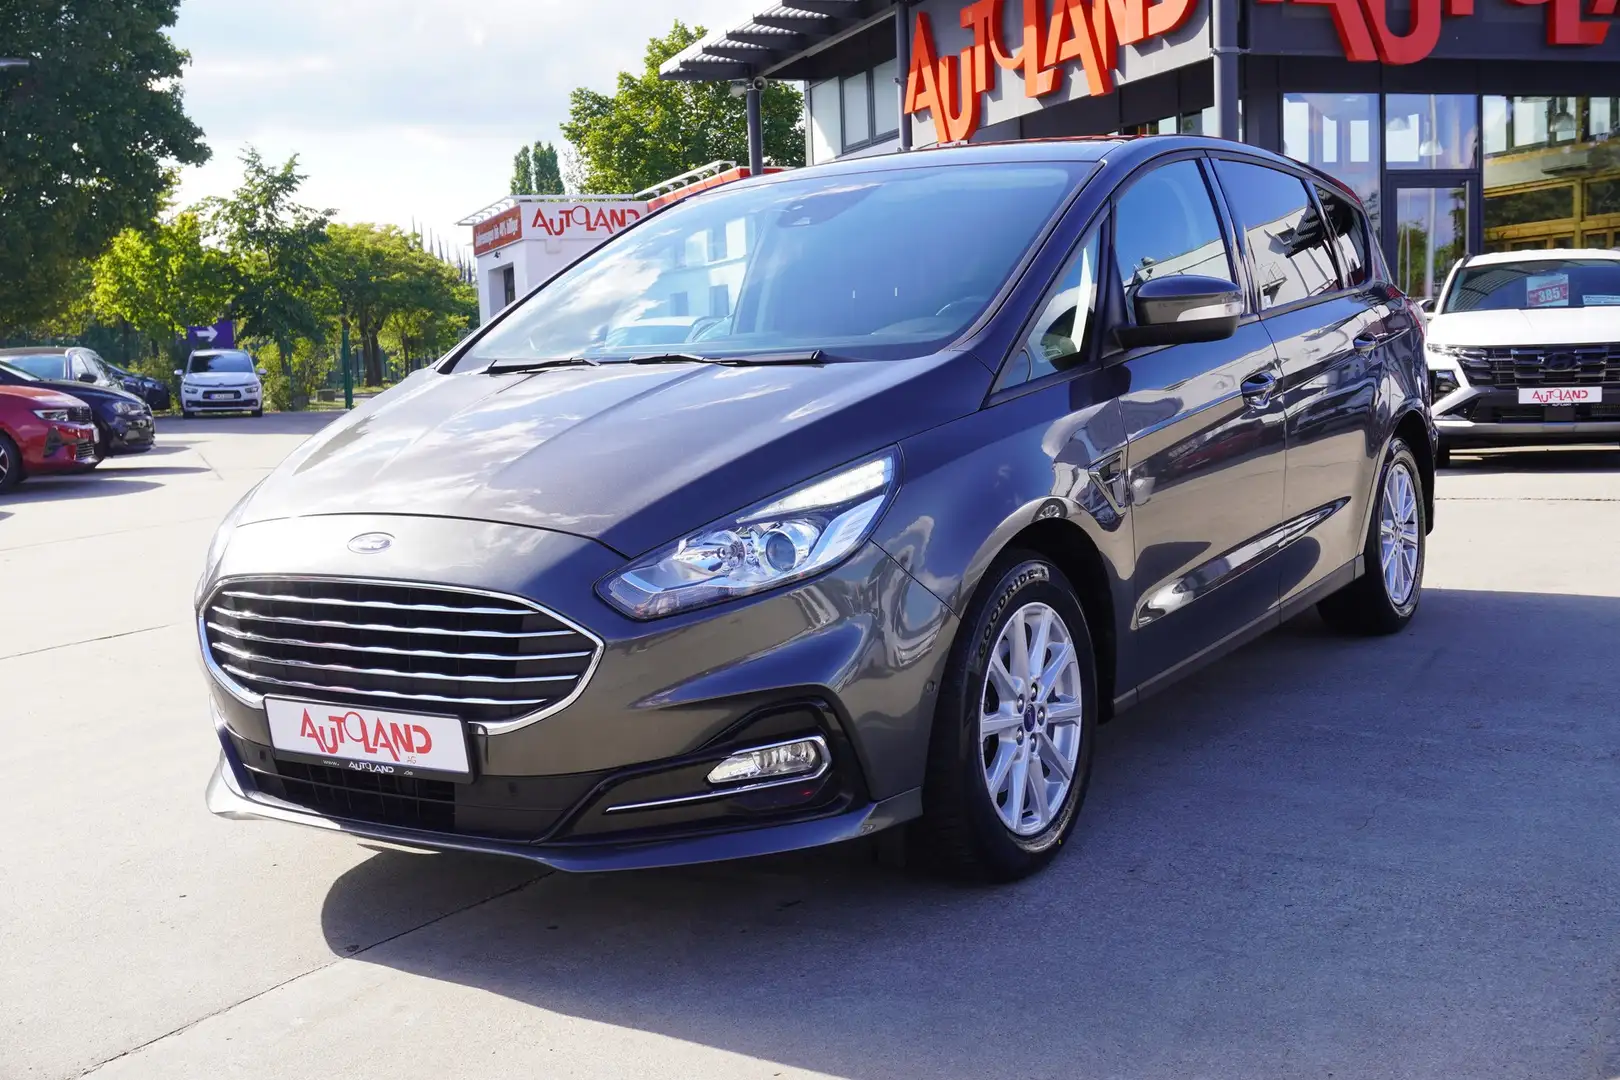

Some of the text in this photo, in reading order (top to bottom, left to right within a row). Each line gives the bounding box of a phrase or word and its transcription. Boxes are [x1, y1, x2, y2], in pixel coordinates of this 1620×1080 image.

[1532, 388, 1589, 403] AUTOLAND
[978, 568, 1036, 660] GOODRIDE
[300, 707, 433, 762] AUTOLAND
[348, 760, 395, 774] AUTOLAND
